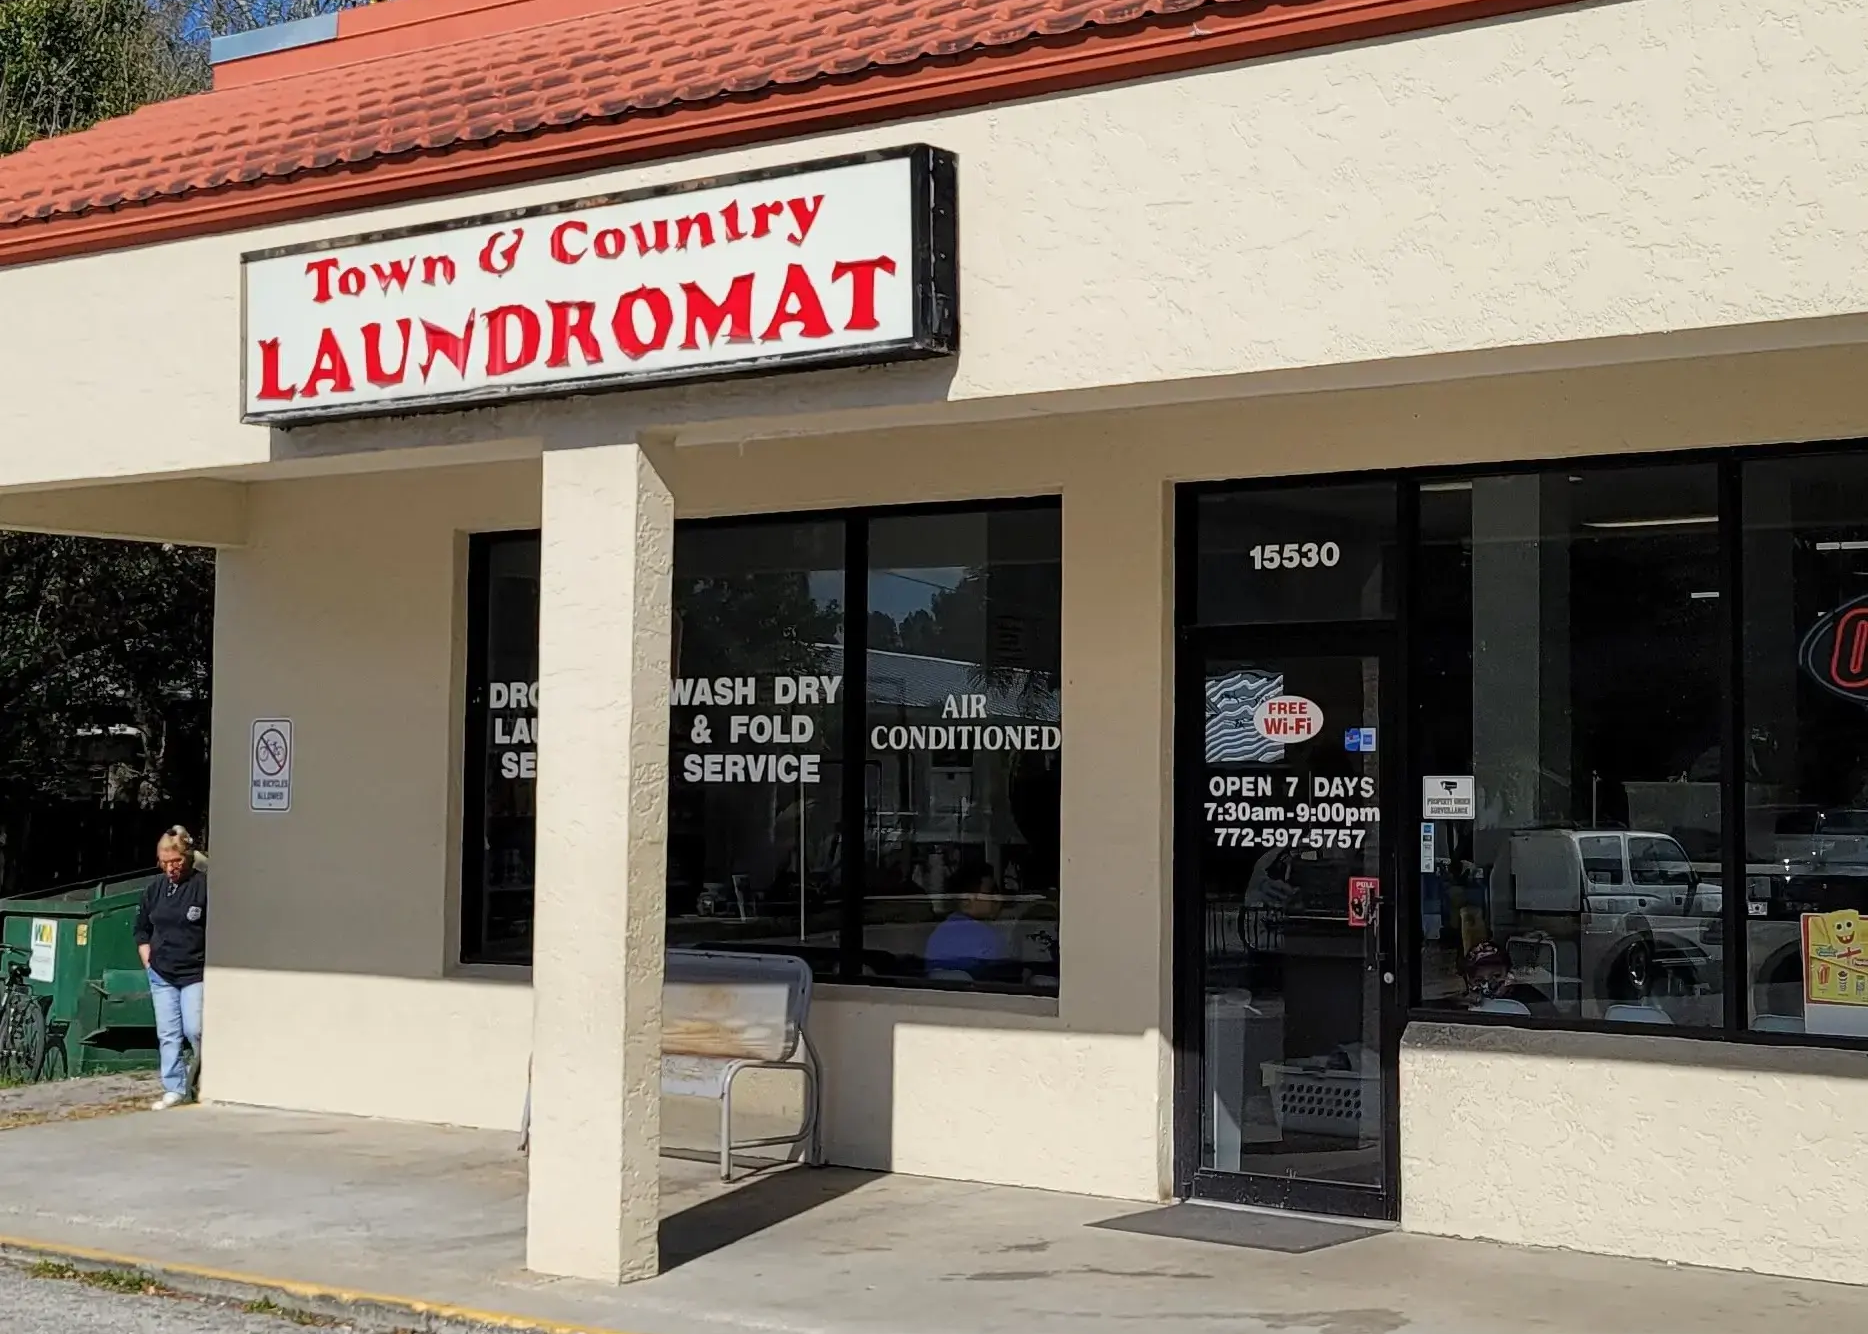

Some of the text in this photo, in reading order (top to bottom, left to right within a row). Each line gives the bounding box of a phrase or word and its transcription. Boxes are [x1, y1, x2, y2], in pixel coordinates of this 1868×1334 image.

[305, 194, 825, 303] Town & Country
[256, 255, 897, 401] LAUNDROMAT
[1250, 541, 1341, 569] 15530
[670, 675, 843, 706] WASH DRY
[941, 694, 987, 719] AIR
[1268, 702, 1308, 715] FREE
[690, 714, 815, 744] & FOLD
[870, 725, 1062, 751] CONDITIONED
[1263, 717, 1312, 735] Wi-Fi
[683, 753, 821, 784] SERVICE
[1209, 776, 1375, 798] OPEN 7 DAYS
[1203, 802, 1381, 827] 7:30am-9:00pm
[1214, 828, 1366, 849] 772-597-5757
[1356, 881, 1374, 889] PULL
